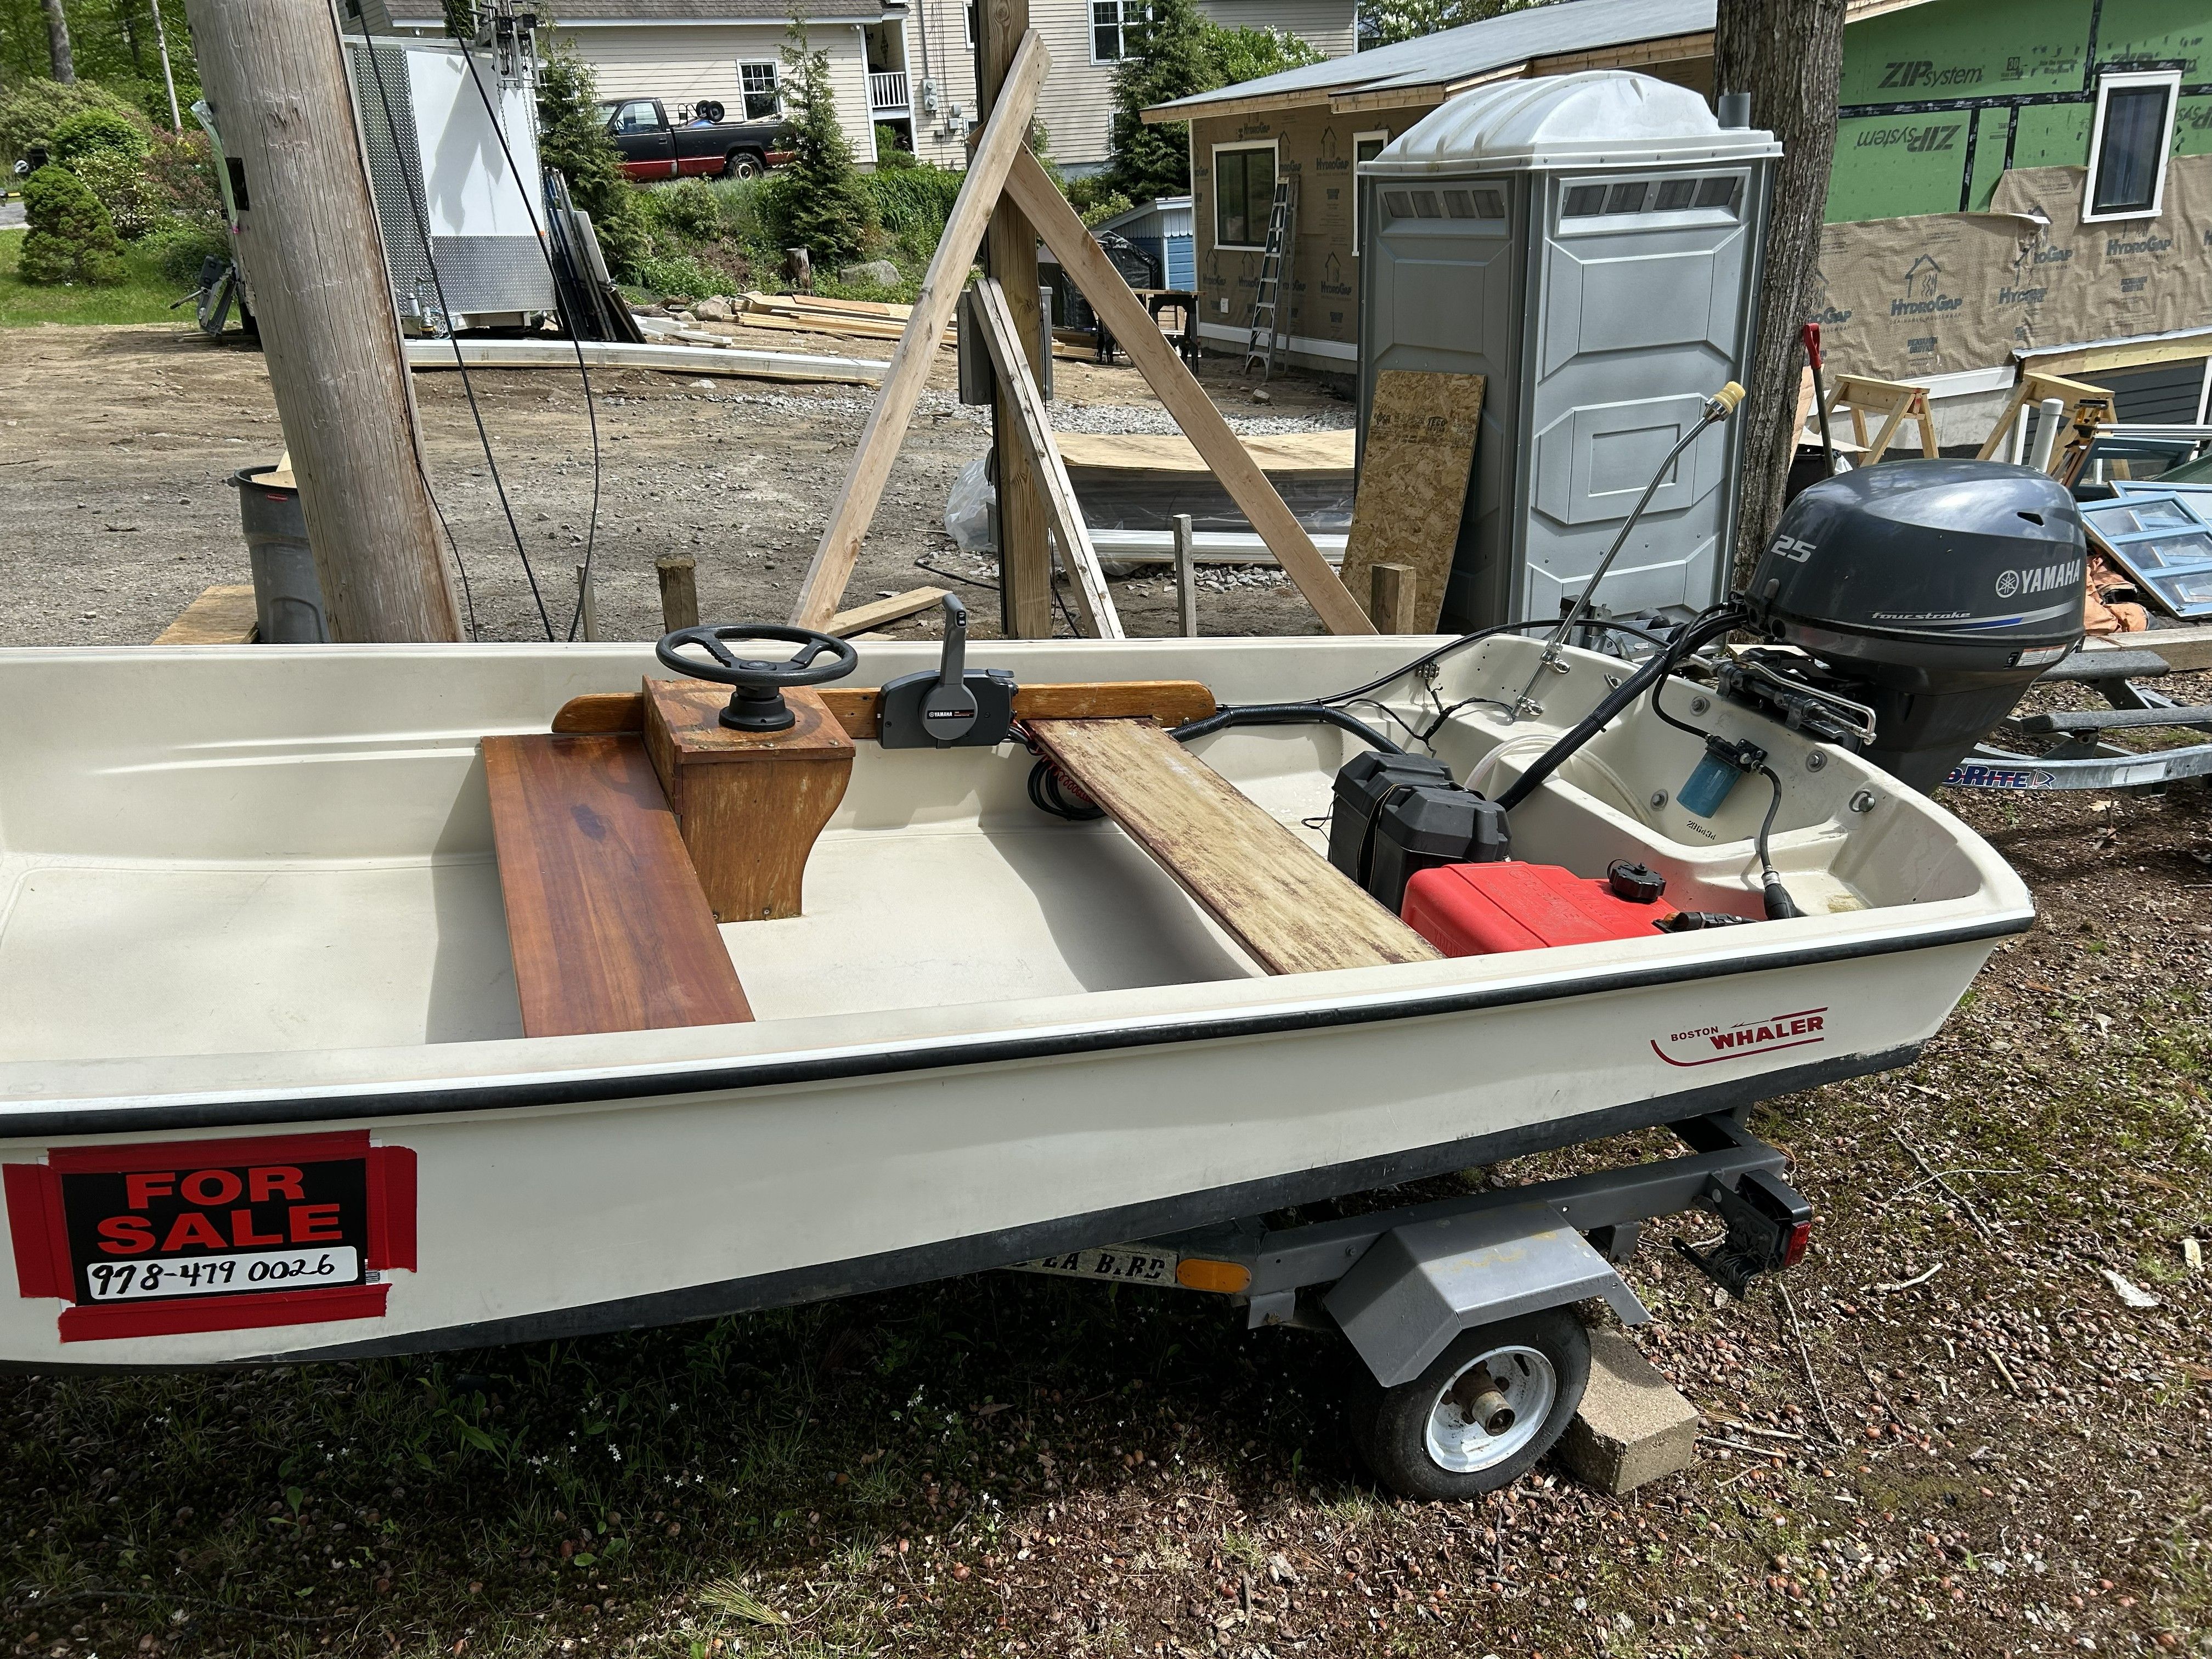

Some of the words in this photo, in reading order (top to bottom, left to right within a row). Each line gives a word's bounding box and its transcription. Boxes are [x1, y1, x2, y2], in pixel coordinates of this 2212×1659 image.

[1770, 534, 1818, 563] 25
[2022, 558, 2081, 595] YAMAHA
[1671, 1026, 1719, 1042] BOSTON
[1708, 1016, 1825, 1051] WHALER
[126, 1166, 306, 1209] FOR
[97, 1204, 343, 1254] SALE
[92, 1261, 236, 1295] 978-479
[248, 1254, 335, 1281] 0026
